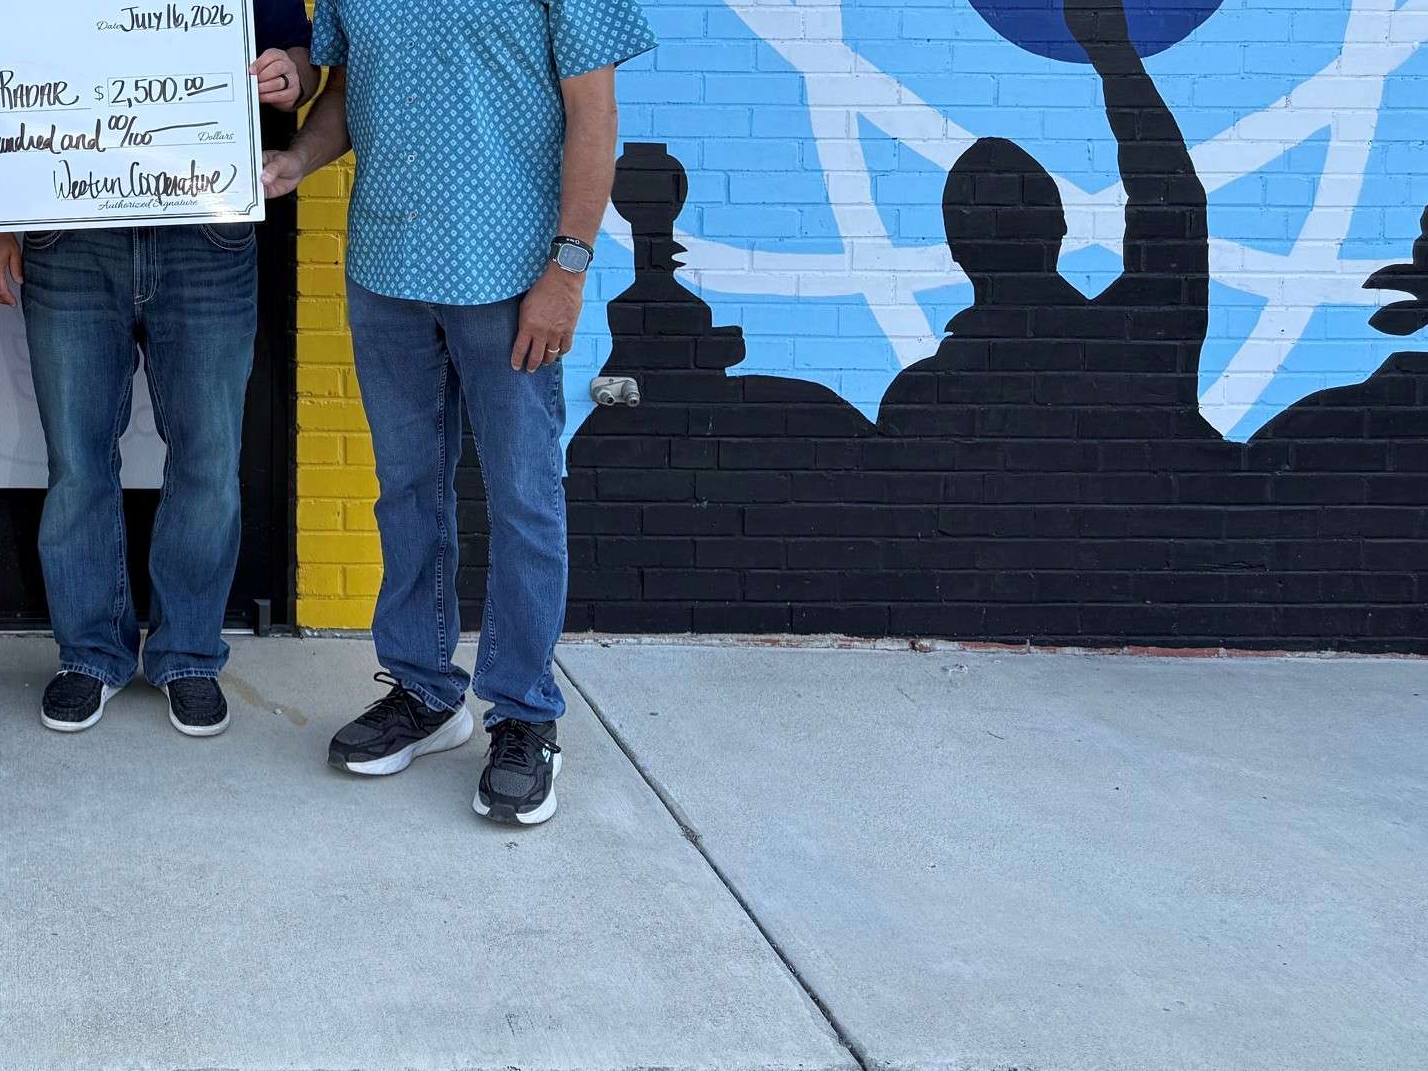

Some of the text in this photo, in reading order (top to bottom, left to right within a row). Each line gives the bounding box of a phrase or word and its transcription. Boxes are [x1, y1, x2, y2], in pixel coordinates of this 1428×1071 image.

[166, 3, 189, 32] 16,
[190, 4, 234, 27] 2026
[94, 86, 104, 101] $
[61, 118, 106, 152] and
[198, 131, 234, 142] Dollars
[98, 198, 198, 212] Authorized Signature
